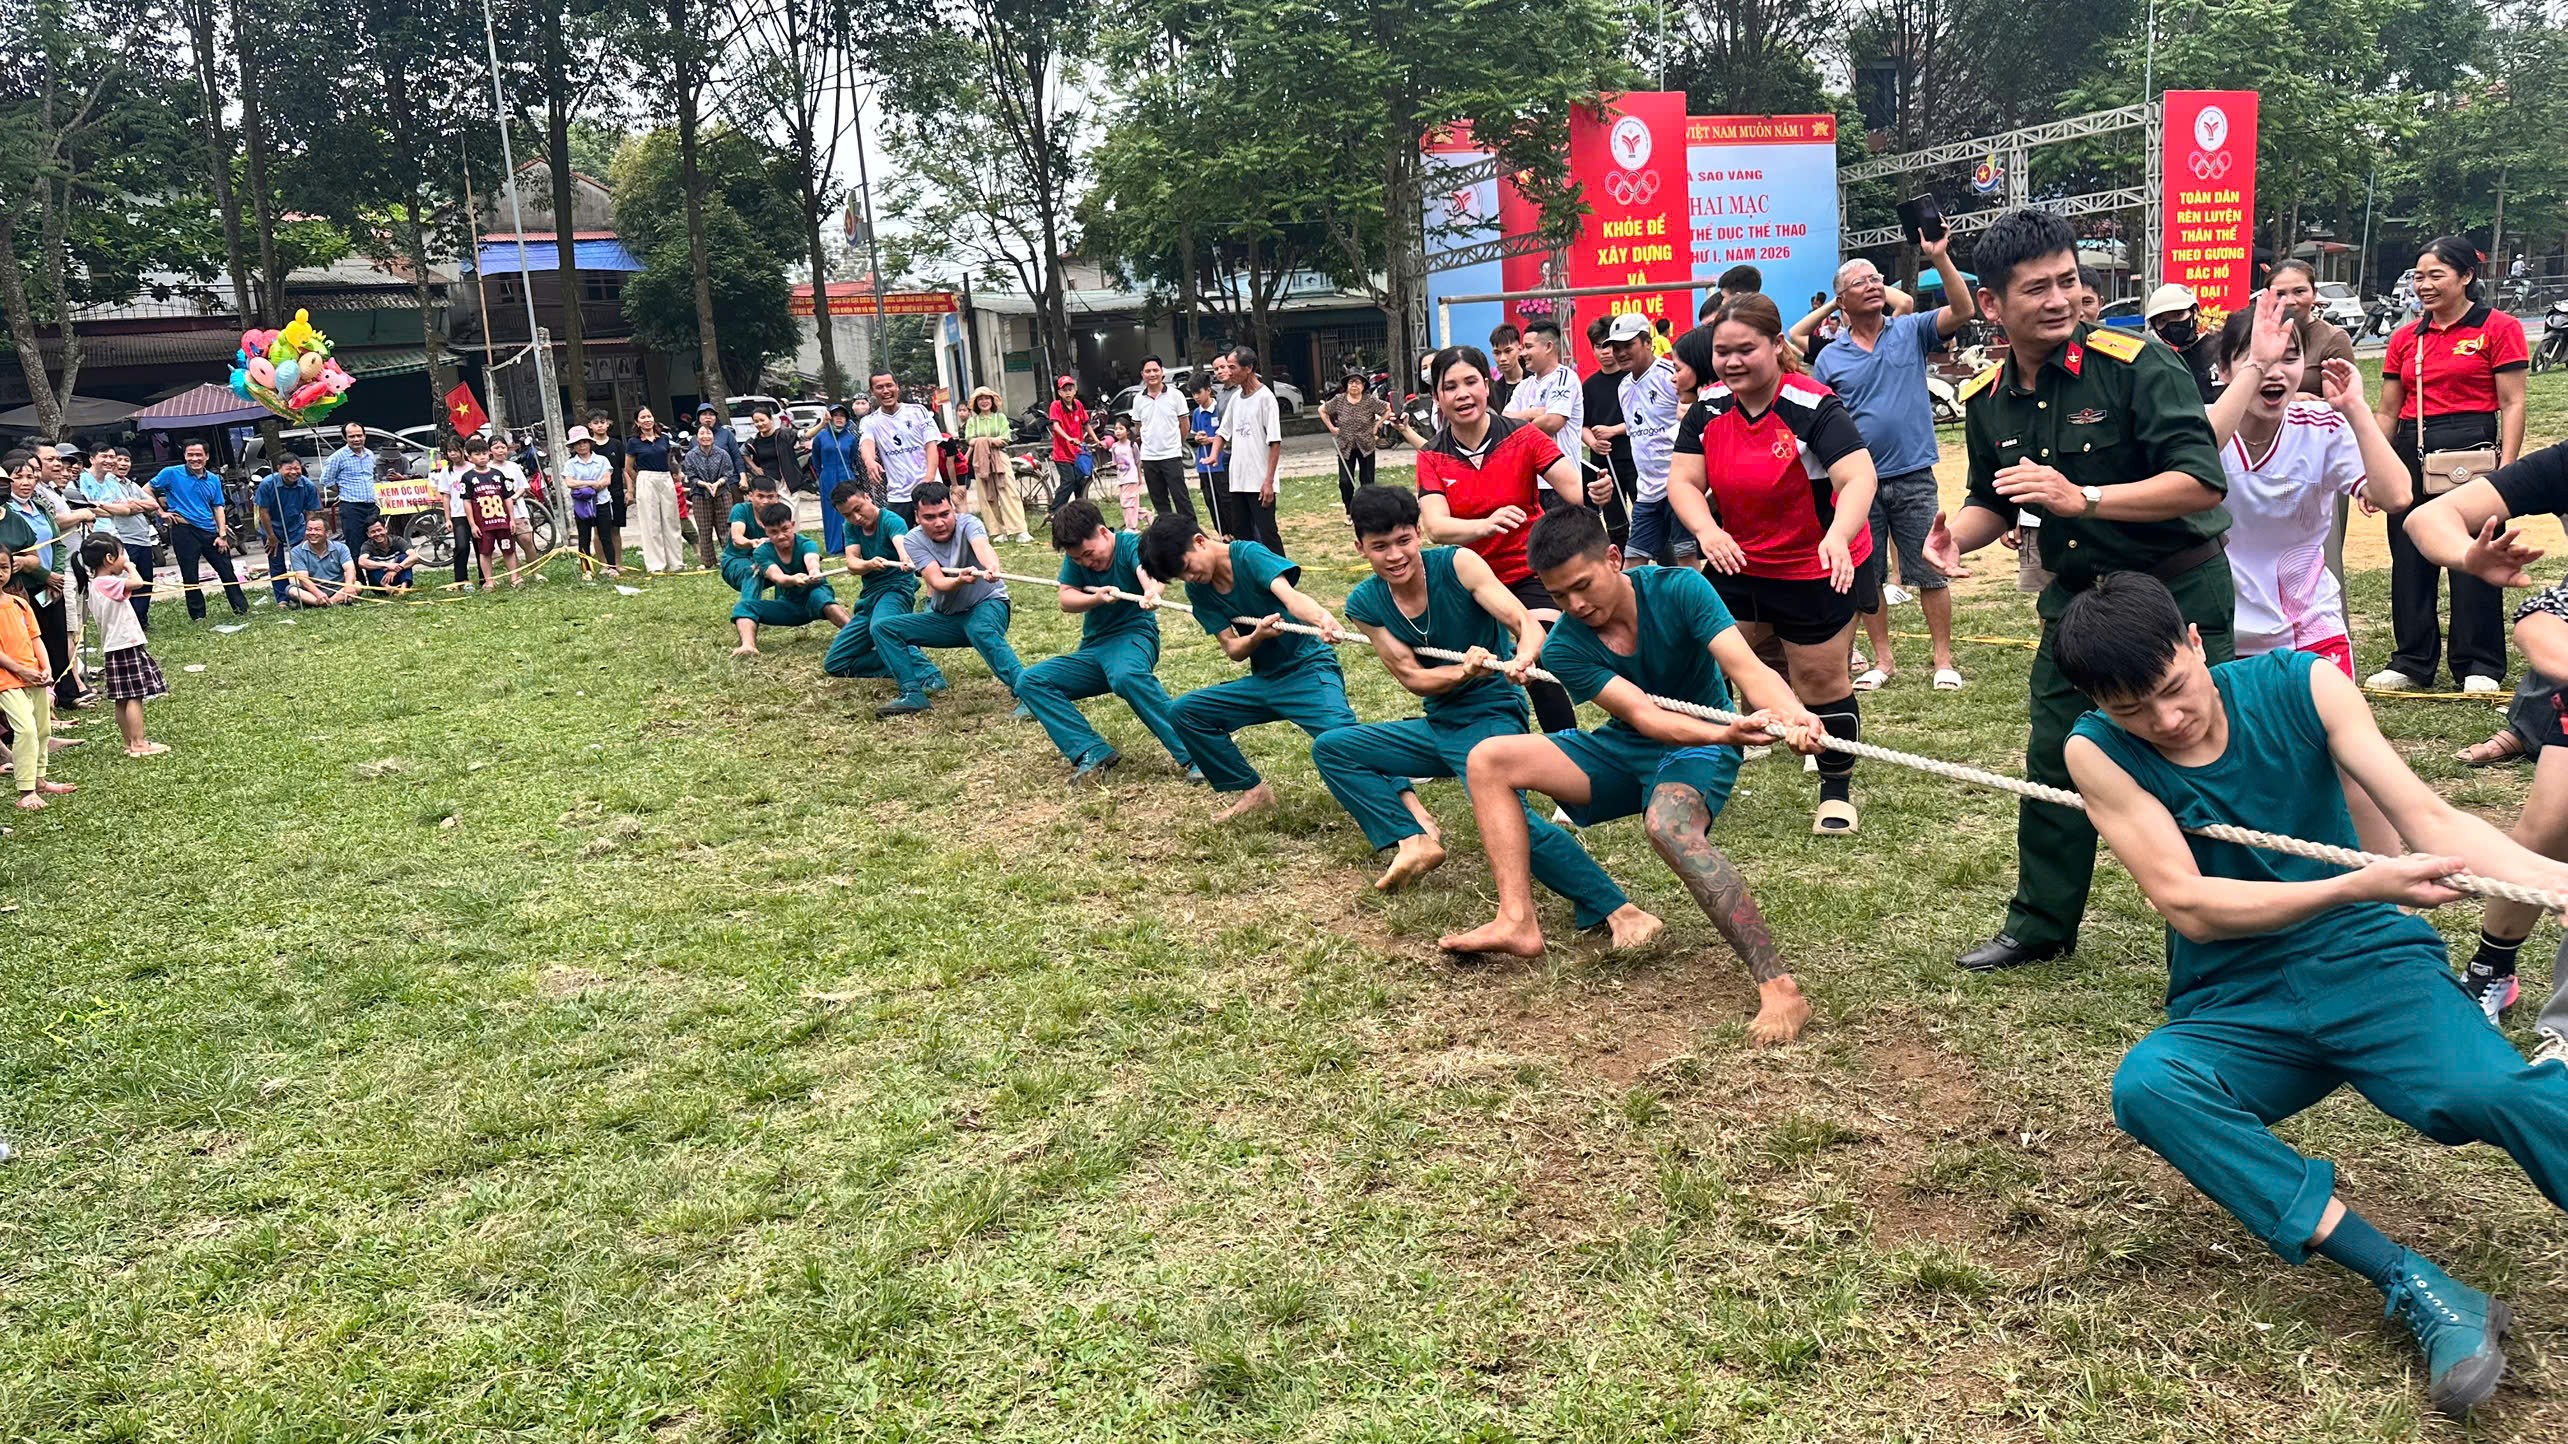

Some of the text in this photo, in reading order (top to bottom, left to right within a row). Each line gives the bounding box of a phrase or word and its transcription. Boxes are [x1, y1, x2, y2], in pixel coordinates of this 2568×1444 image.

[1712, 126, 1737, 138] NAM
[1739, 122, 1772, 138] MUÔN
[1774, 122, 1798, 137] NĂM
[1698, 171, 1724, 182] SAO
[1728, 168, 1763, 181] VÀNG
[2179, 188, 2240, 205] TOÀN DÂN
[1689, 194, 1769, 219] HAI MẠC
[2177, 207, 2242, 224] RÈN LUYỆN
[1603, 212, 1666, 238] KHỎE ĐỂ
[1717, 226, 1744, 243] DỤC
[1748, 220, 1771, 239] THỂ
[1775, 223, 1806, 237] THAO
[2181, 224, 2237, 242] THÂN THỂ
[1597, 243, 1672, 265] XÂY DỰNG
[1691, 248, 1710, 264] HỨ
[1725, 246, 1756, 262] NĂM
[1760, 246, 1790, 260] 2026
[2172, 246, 2245, 262] THEO GƯƠNG
[1627, 269, 1647, 287] VÀ
[2186, 265, 2210, 280] BÁC
[2200, 285, 2220, 300] ĐẠI
[1611, 293, 1664, 317] BẢO VỆ
[380, 487, 399, 497] KEM
[414, 484, 428, 495] QU
[385, 499, 404, 509] KEM
[480, 495, 504, 518] 88
